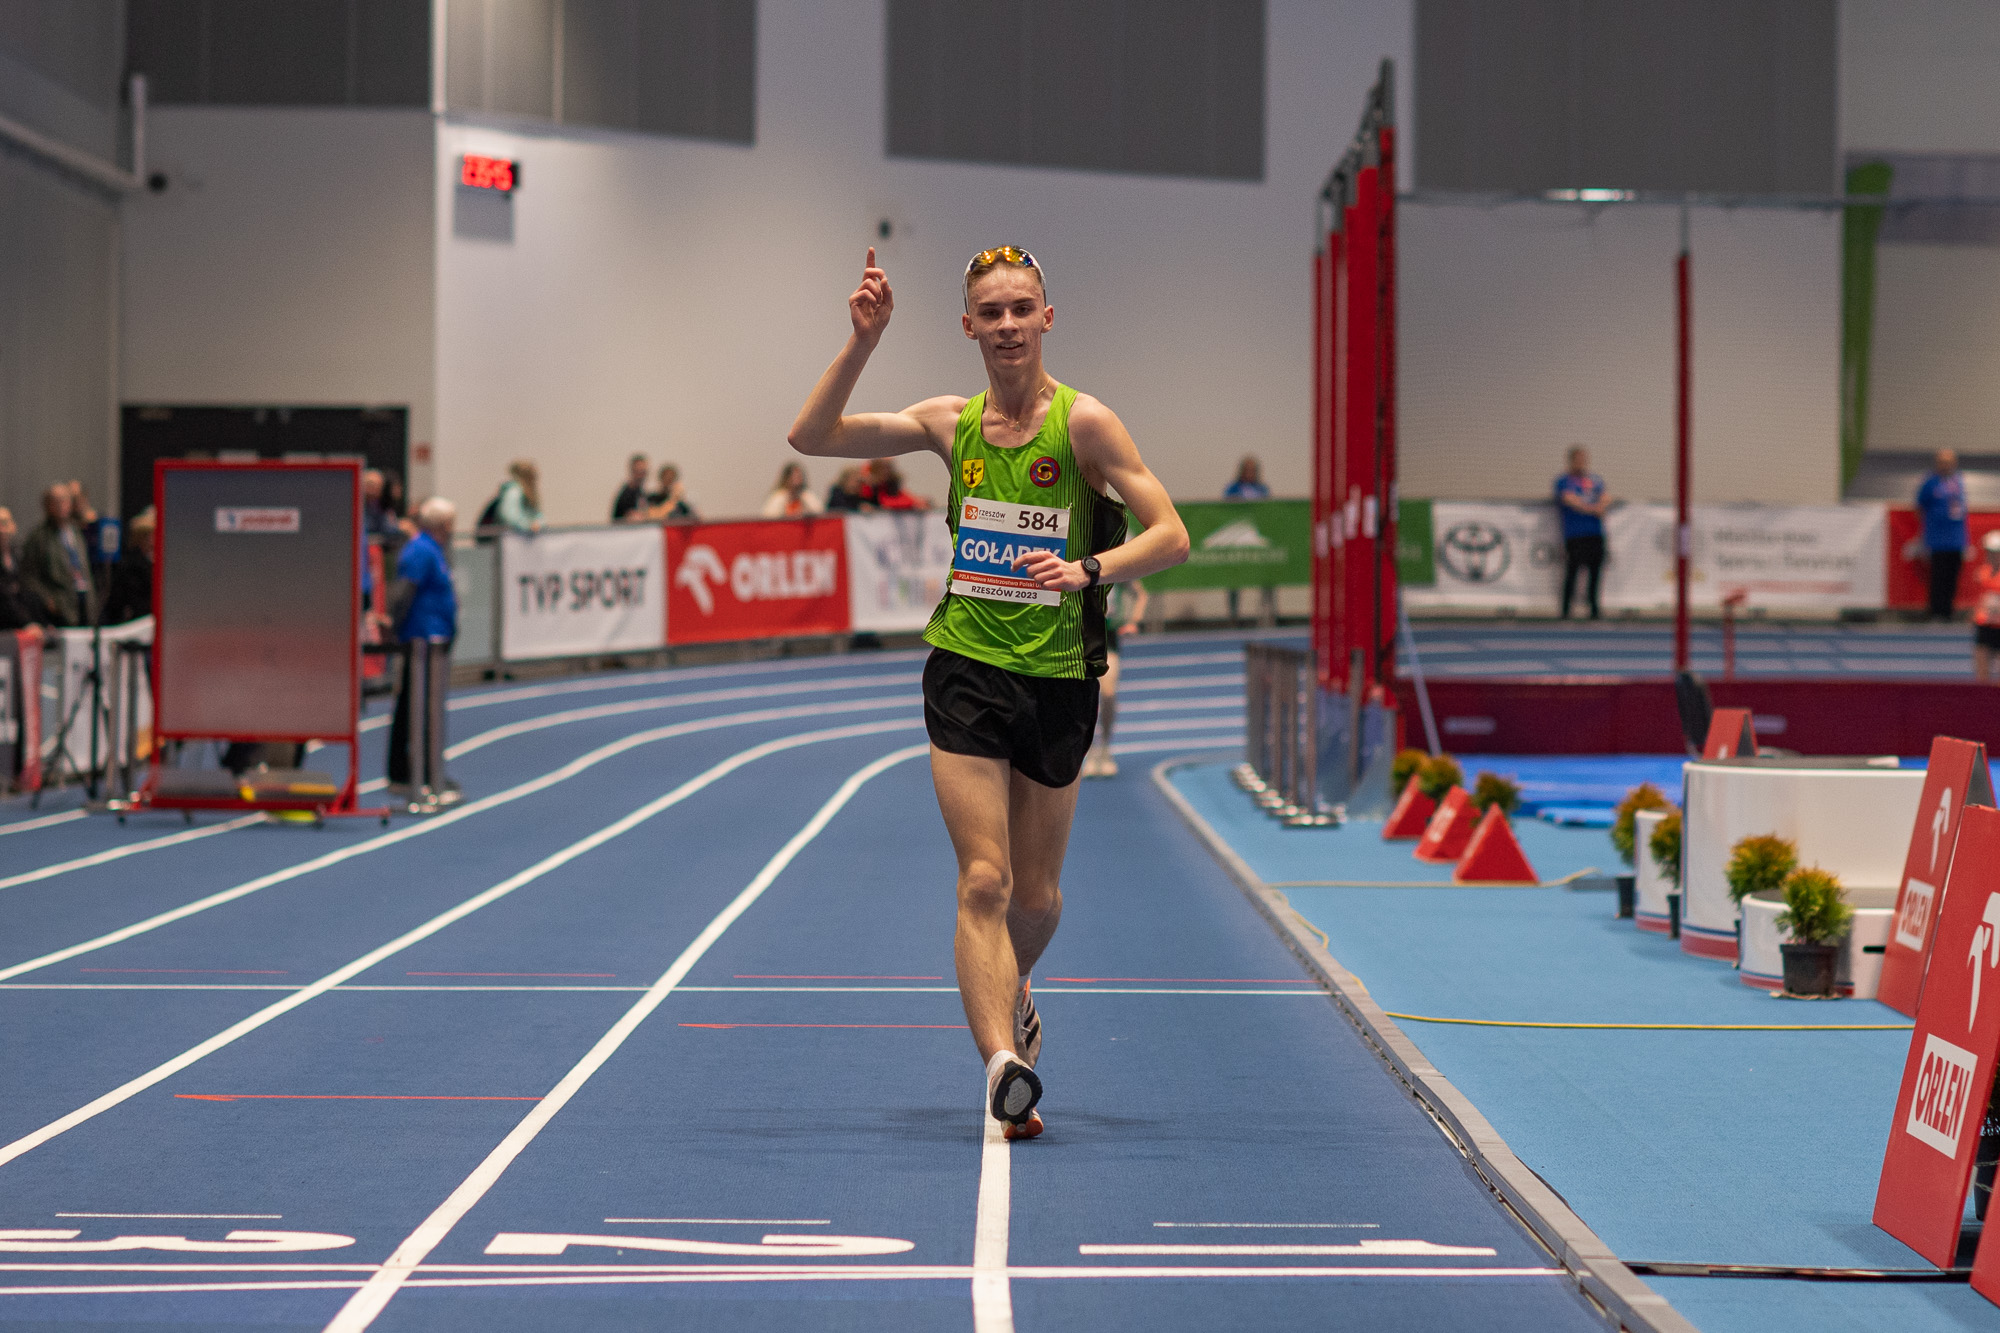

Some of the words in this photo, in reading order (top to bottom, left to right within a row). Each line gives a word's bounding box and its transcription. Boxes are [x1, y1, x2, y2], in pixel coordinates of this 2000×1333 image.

[978, 509, 1006, 519] rzeszów
[1017, 510, 1058, 532] 584
[731, 549, 838, 602] ORLEN
[987, 577, 1018, 586] Mistrzostwa
[518, 572, 563, 614] TVP
[569, 567, 646, 611] SPORT
[971, 585, 1013, 598] RZESZÓW
[1015, 590, 1038, 600] 2023
[1915, 1051, 1970, 1141] ORLEN
[0, 1230, 356, 1252] 3
[483, 1232, 915, 1256] 2
[1079, 1239, 1497, 1256] 1
